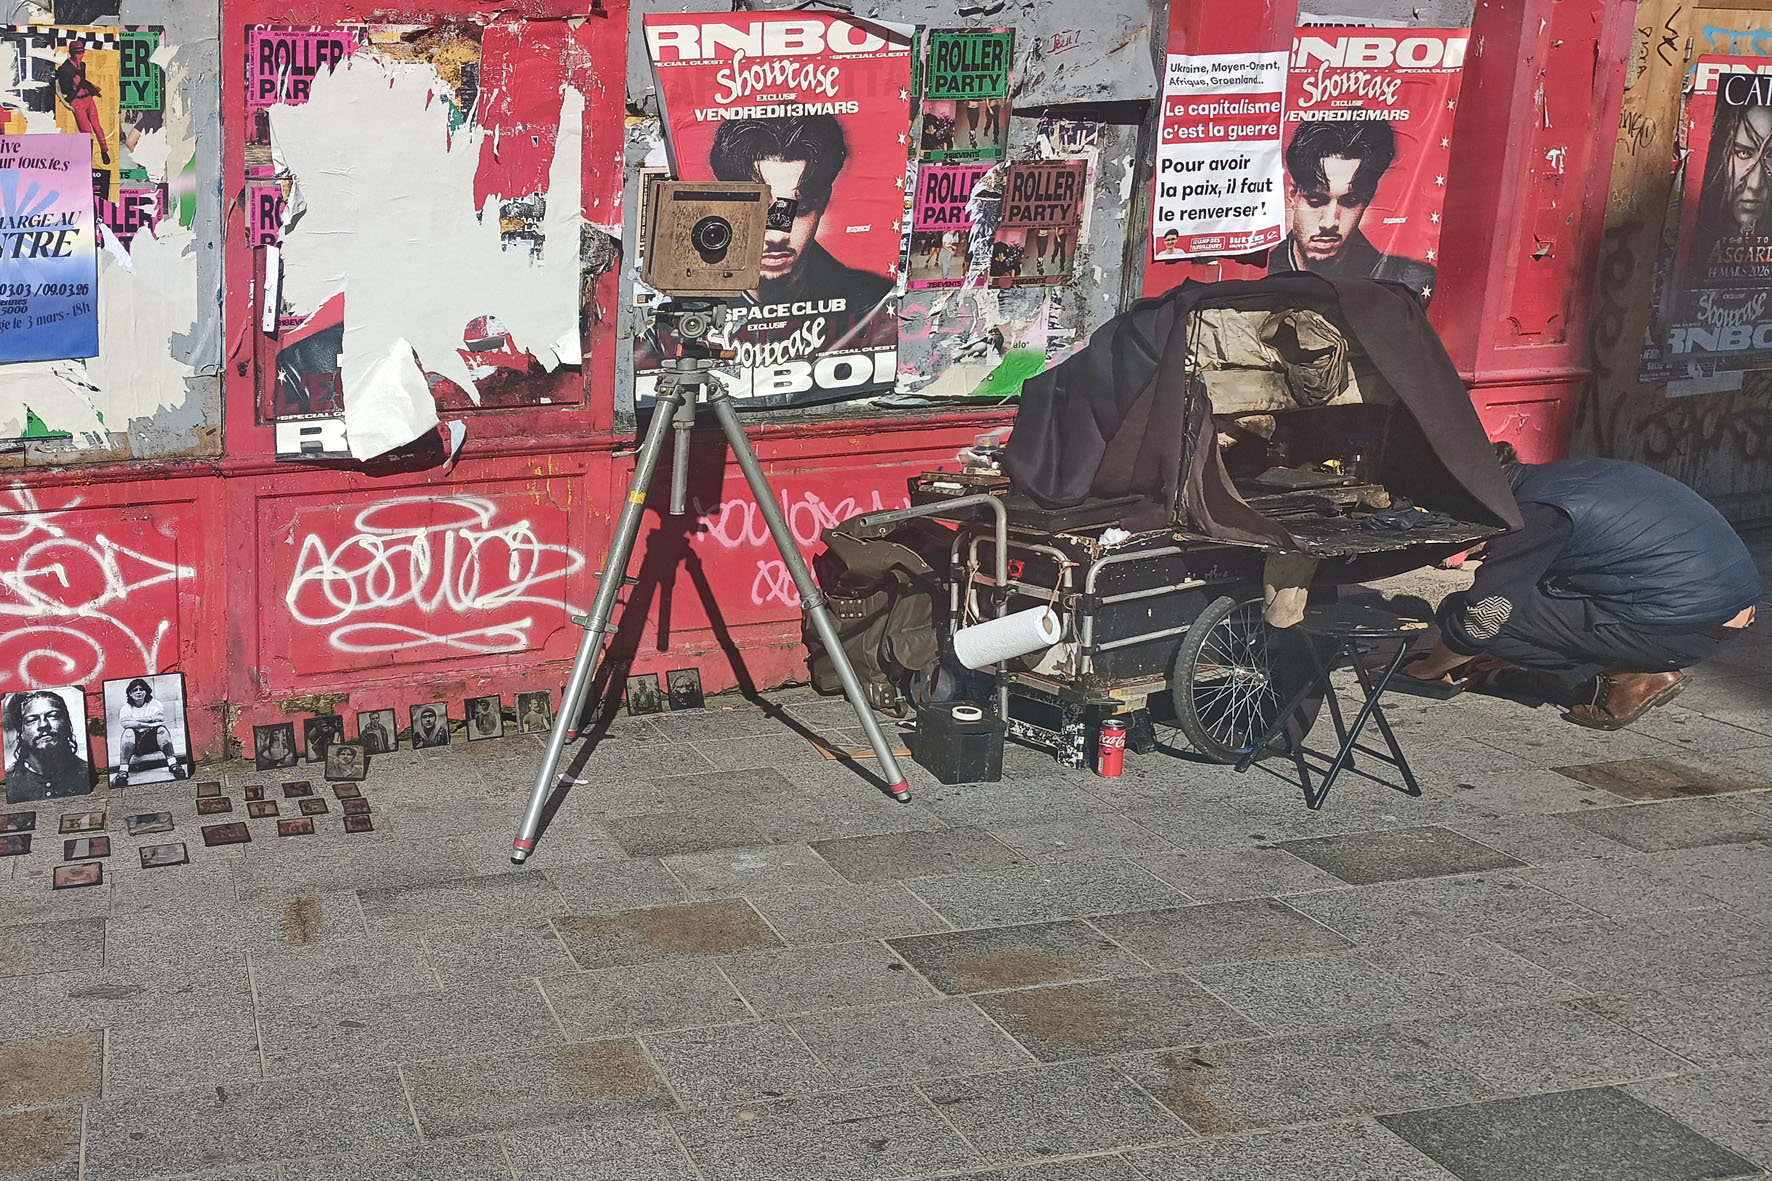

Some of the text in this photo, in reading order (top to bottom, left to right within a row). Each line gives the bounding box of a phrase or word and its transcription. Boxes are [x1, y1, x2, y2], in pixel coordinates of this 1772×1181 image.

[936, 40, 1004, 73] ROLLER
[1291, 37, 1469, 68] NBOI
[714, 48, 840, 104] Showcase
[1170, 62, 1209, 74] Ukraine,
[935, 74, 1002, 93] PARTY
[1169, 77, 1209, 87] Afrique,
[1298, 59, 1401, 107] Showcase
[756, 93, 798, 101] EXCLUSIF
[1165, 99, 1281, 118] Le capitalisme
[1163, 122, 1277, 140] c'est la guerre
[0, 139, 21, 154] ive
[1161, 154, 1251, 173] Pour avoir
[1011, 171, 1076, 202] ROLLER
[1160, 177, 1273, 200] la paix, il faut
[54, 210, 82, 226] AU
[1008, 203, 1072, 222] PARTY
[1159, 206, 1175, 222] le
[1179, 205, 1258, 221] renverser
[13, 317, 22, 329] le
[24, 315, 33, 329] 3
[36, 310, 64, 325] mars
[71, 301, 90, 317] 18h
[791, 298, 847, 316] CLUB
[1697, 291, 1767, 329] Showcase
[747, 321, 788, 331] EXCLUSIF
[707, 316, 826, 368] Showcase
